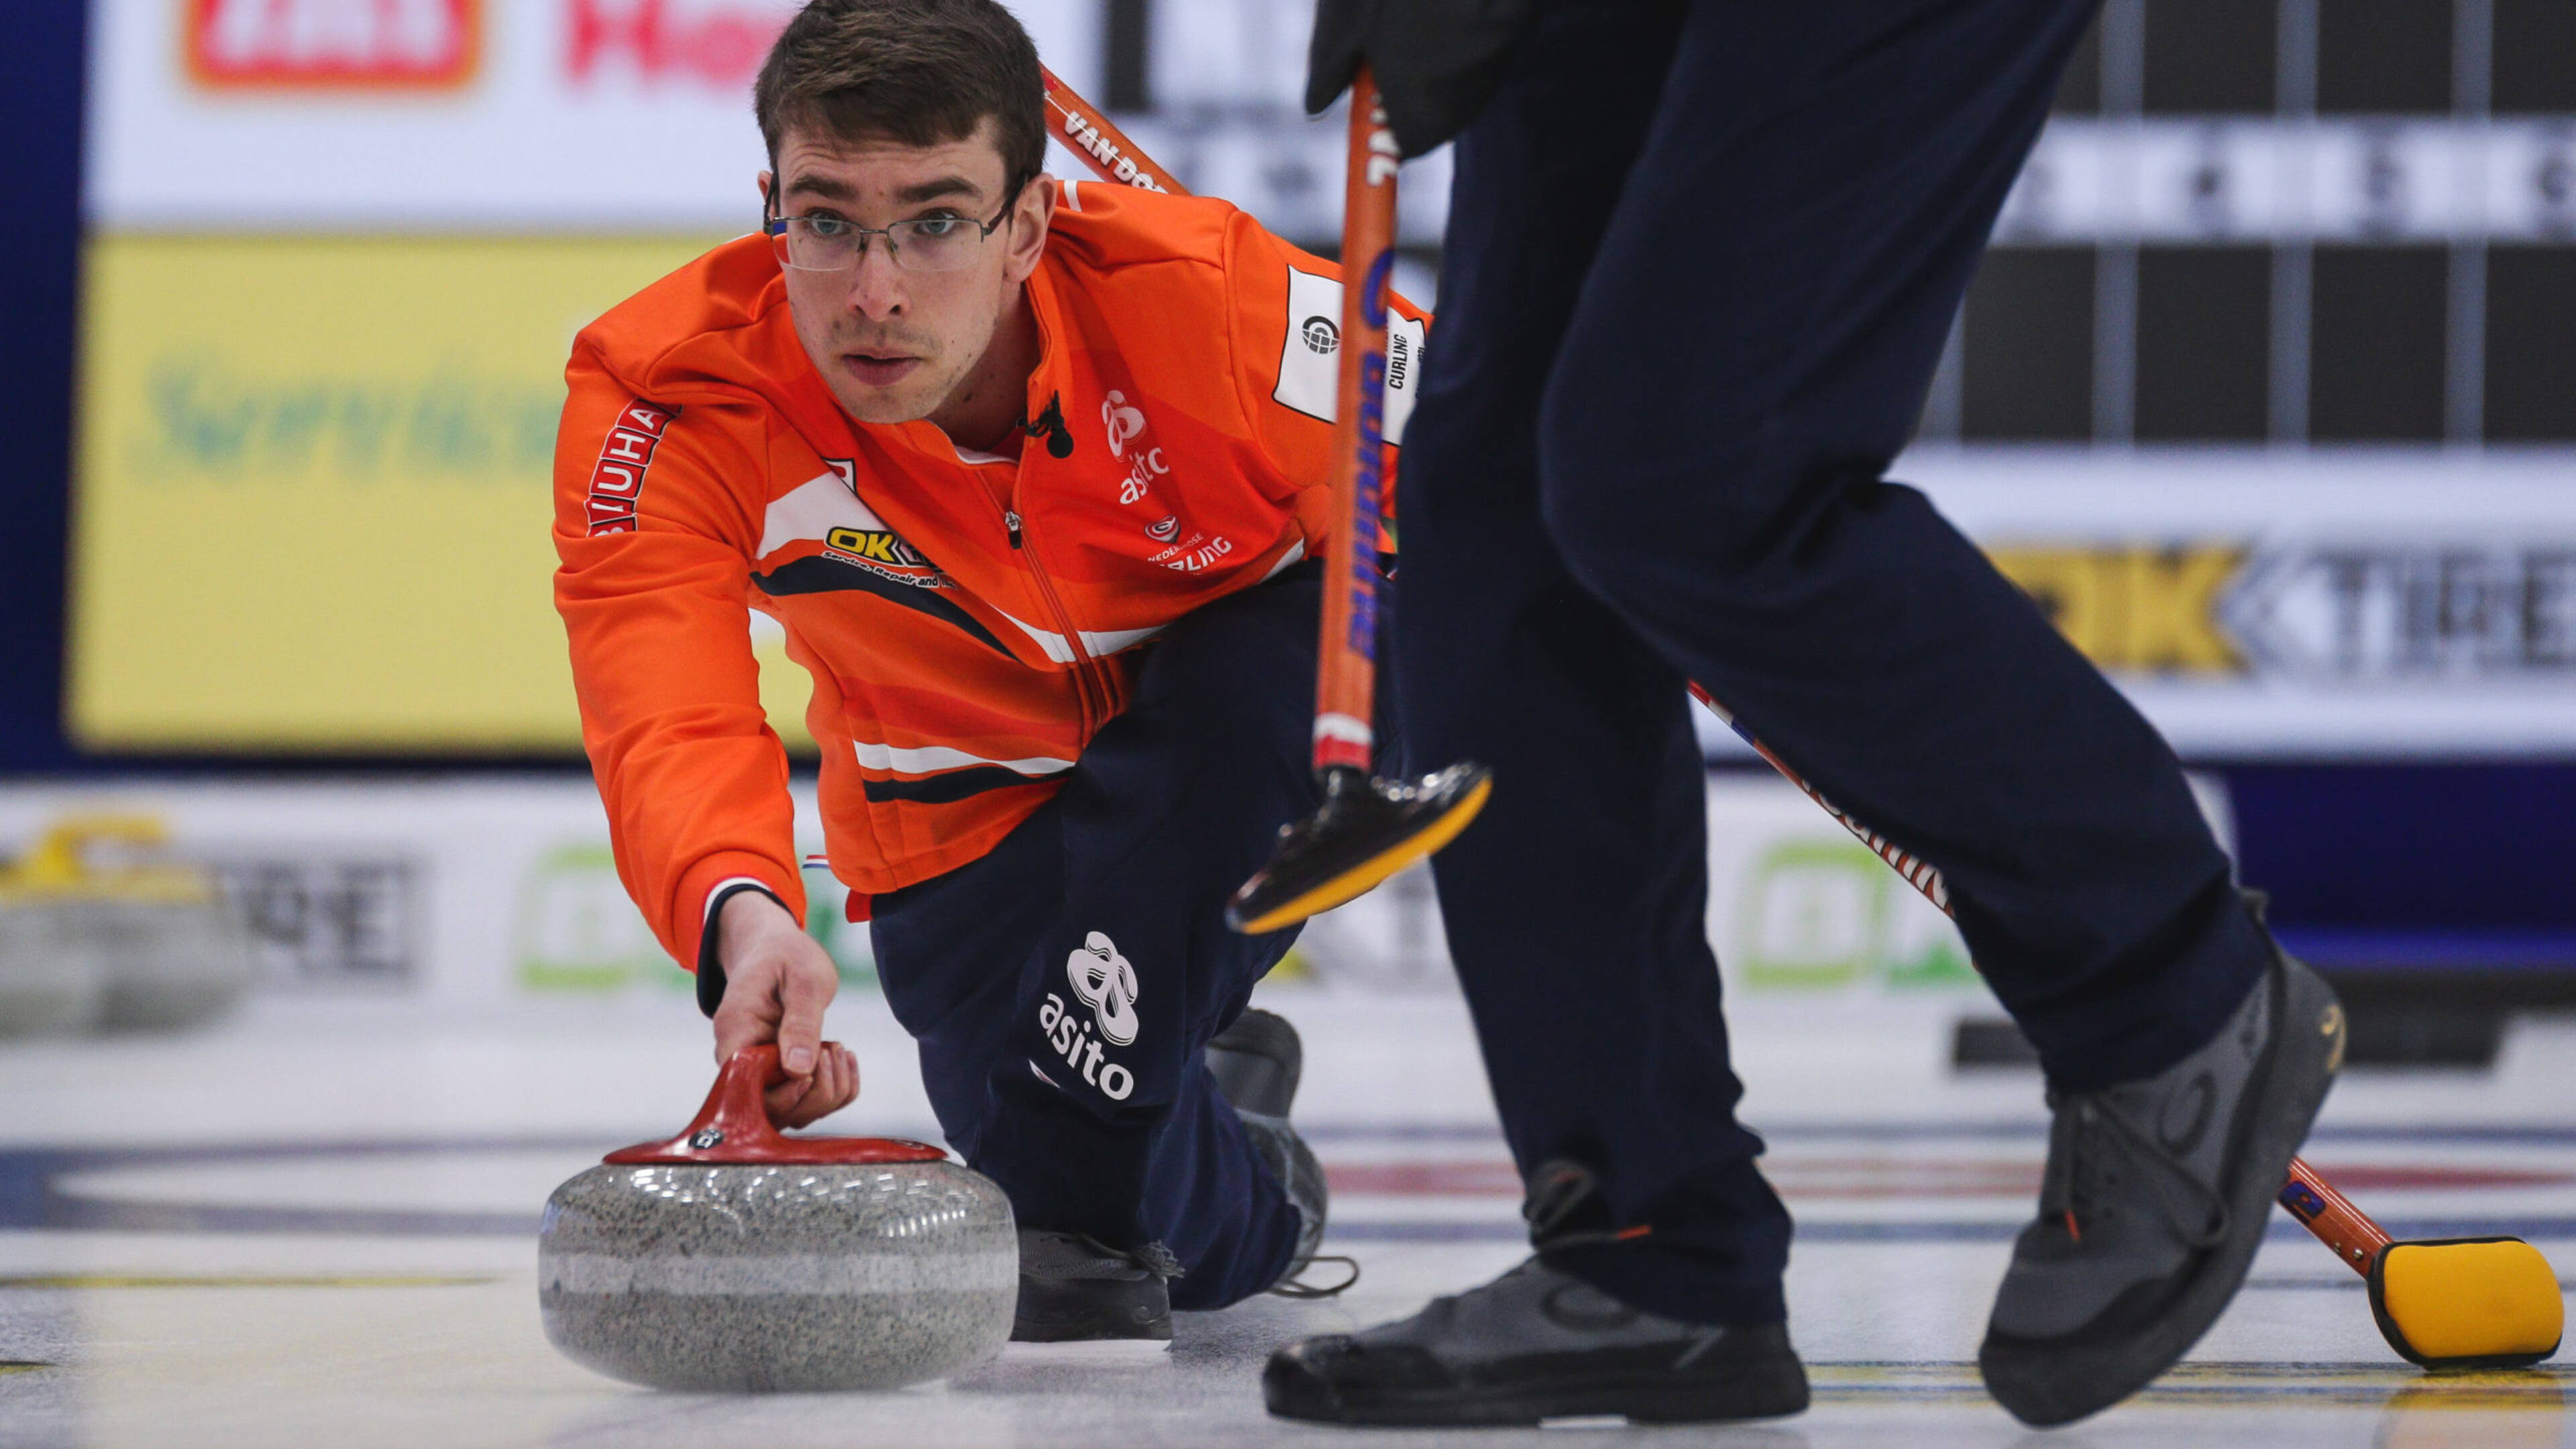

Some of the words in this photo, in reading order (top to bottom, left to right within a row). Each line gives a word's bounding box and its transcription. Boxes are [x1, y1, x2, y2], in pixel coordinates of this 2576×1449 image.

[1064, 111, 1120, 166] VAN
[1113, 156, 1169, 195] DO
[1389, 333, 1408, 390] CURLING
[829, 528, 896, 563] OK
[873, 567, 916, 585] Repair
[917, 574, 938, 587] and
[1040, 992, 1134, 1100] asito
